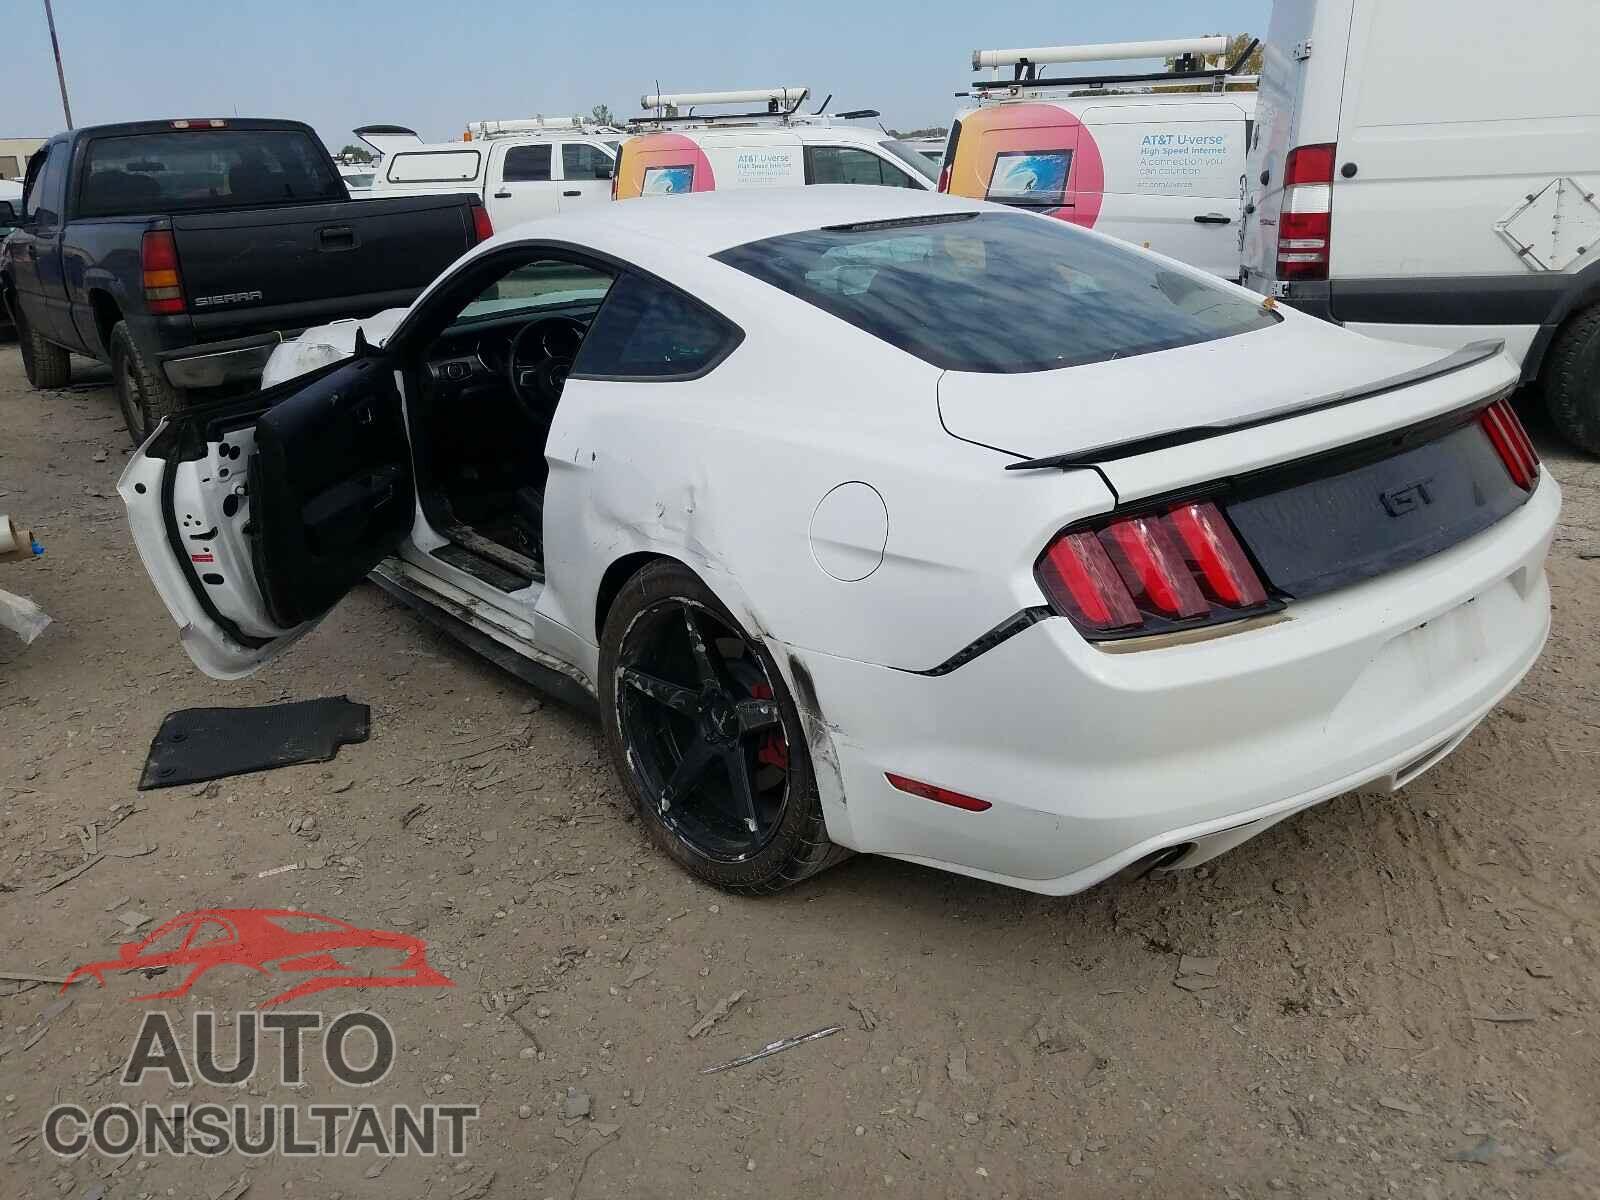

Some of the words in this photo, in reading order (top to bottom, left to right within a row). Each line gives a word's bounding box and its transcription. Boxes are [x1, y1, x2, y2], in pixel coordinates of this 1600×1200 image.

[1143, 135, 1173, 145] AT&T
[1177, 135, 1223, 145] U-verse
[1141, 147, 1160, 157] High
[1161, 147, 1188, 157] Speed
[1140, 158, 1147, 166] A
[1149, 158, 1202, 166] connection
[1206, 159, 1223, 168] you
[1139, 167, 1157, 175] can
[1159, 167, 1186, 175] count
[194, 290, 263, 306] SIERRA
[1380, 478, 1434, 517] GT
